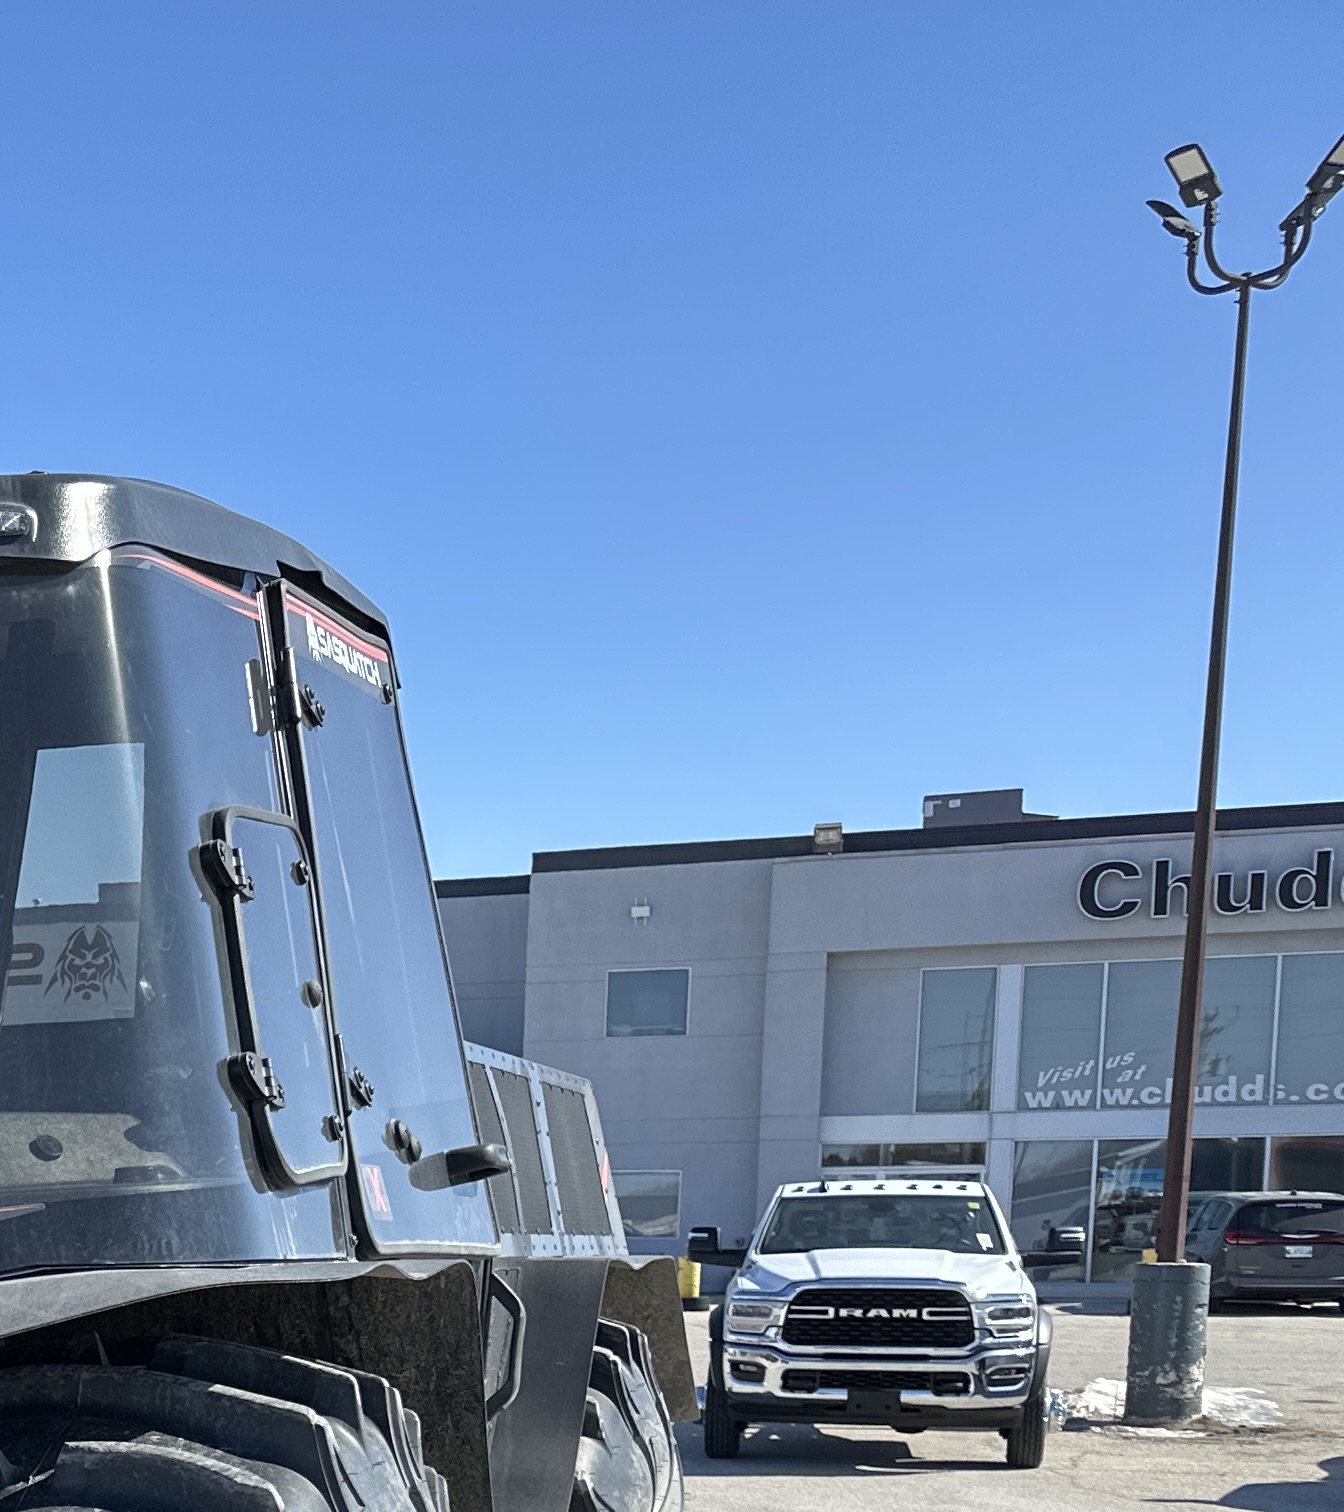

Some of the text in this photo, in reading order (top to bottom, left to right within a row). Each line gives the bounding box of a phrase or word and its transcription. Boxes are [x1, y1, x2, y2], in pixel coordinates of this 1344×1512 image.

[1078, 847, 1344, 921] Chud
[1037, 1051, 1136, 1088] Visit us
[1116, 1064, 1147, 1083] at
[838, 1307, 918, 1319] RAM
